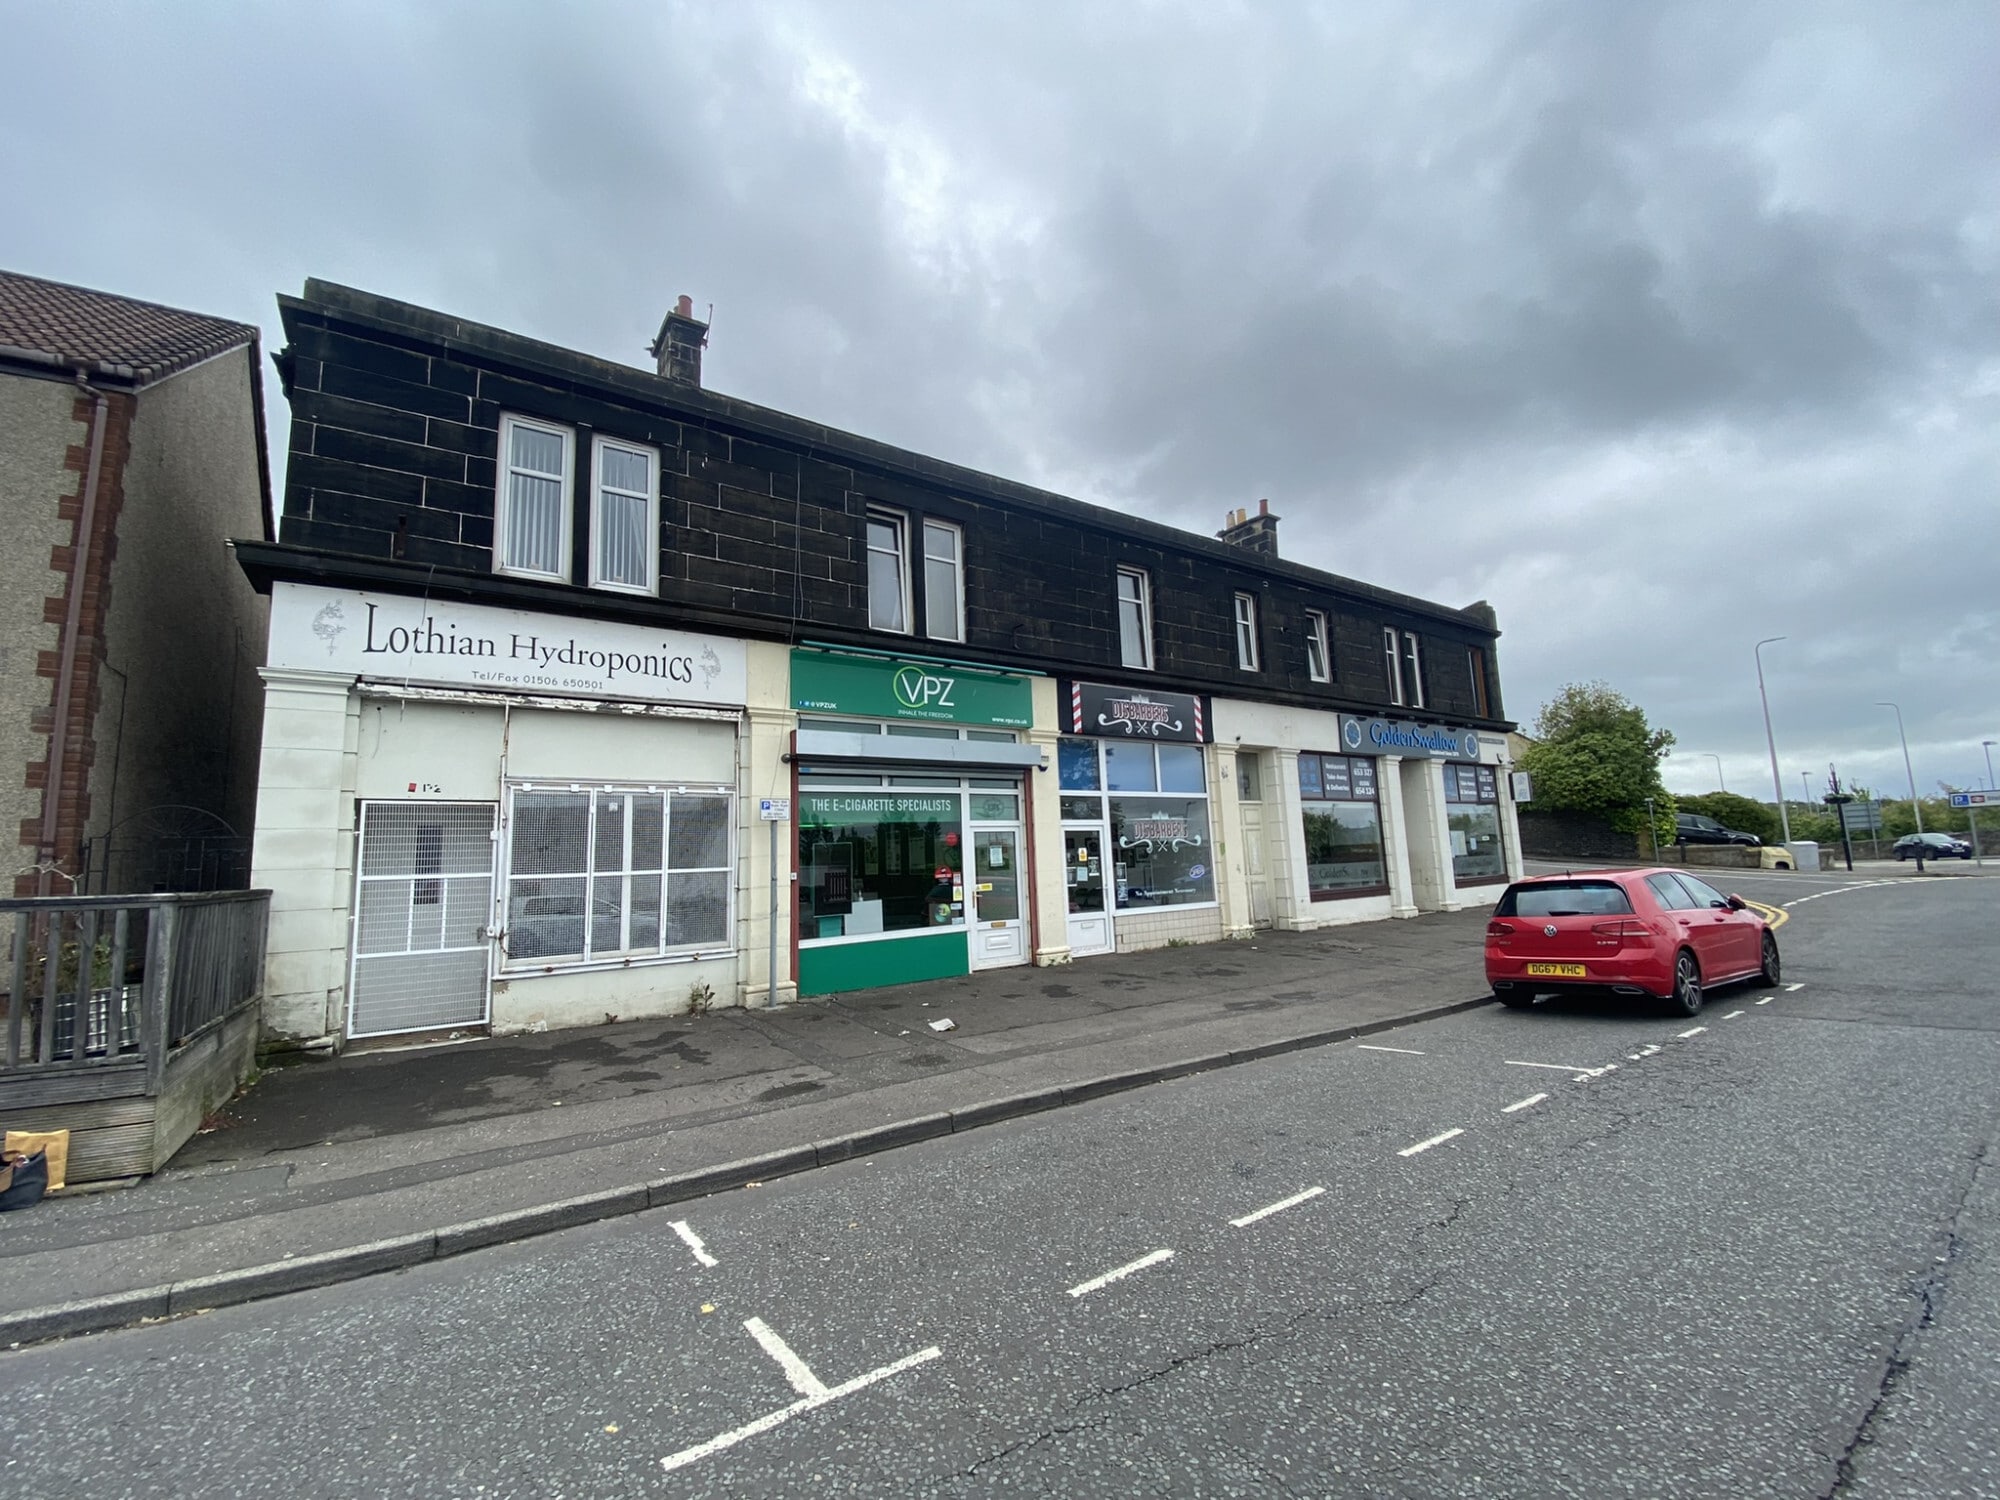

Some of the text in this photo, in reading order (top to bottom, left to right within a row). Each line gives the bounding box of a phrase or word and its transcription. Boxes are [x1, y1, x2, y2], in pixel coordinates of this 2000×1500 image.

[362, 602, 694, 684] Lothian Hydroponics
[471, 670, 604, 690] Tel/Fax 01506 650501
[901, 673, 955, 706] VPZ
[928, 711, 953, 719] FREEDOM
[811, 799, 951, 812] THE E-CIGARETTE SPECIALISTS
[1532, 964, 1581, 975] DG67 VHC
